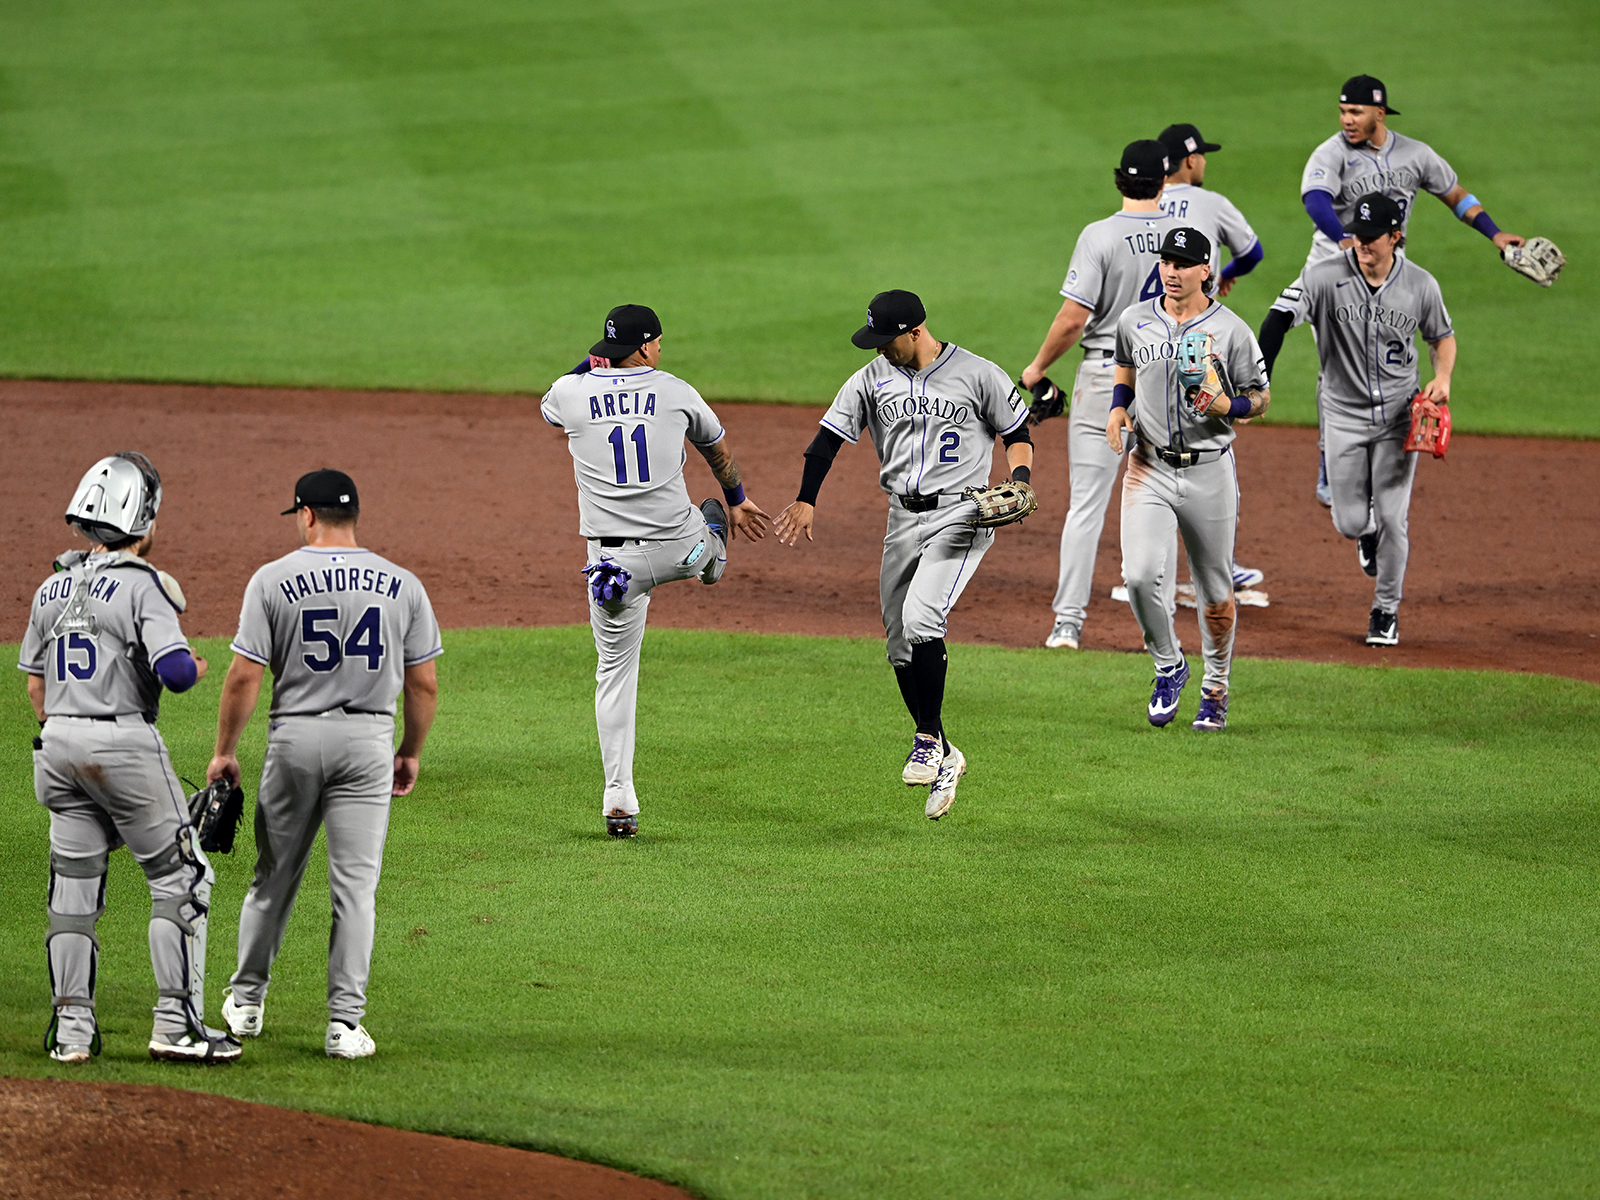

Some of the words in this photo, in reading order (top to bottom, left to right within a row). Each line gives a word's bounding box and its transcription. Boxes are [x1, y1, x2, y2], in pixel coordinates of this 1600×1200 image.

[1328, 303, 1417, 333] COLORADO
[589, 392, 656, 421] ARCIA
[876, 395, 968, 428] COLORADO
[608, 423, 652, 484] 11
[938, 430, 961, 463] 2
[40, 574, 122, 609] GOOAN
[279, 567, 403, 604] HALVORSEN
[56, 618, 98, 682] 15
[300, 605, 385, 674] 54
